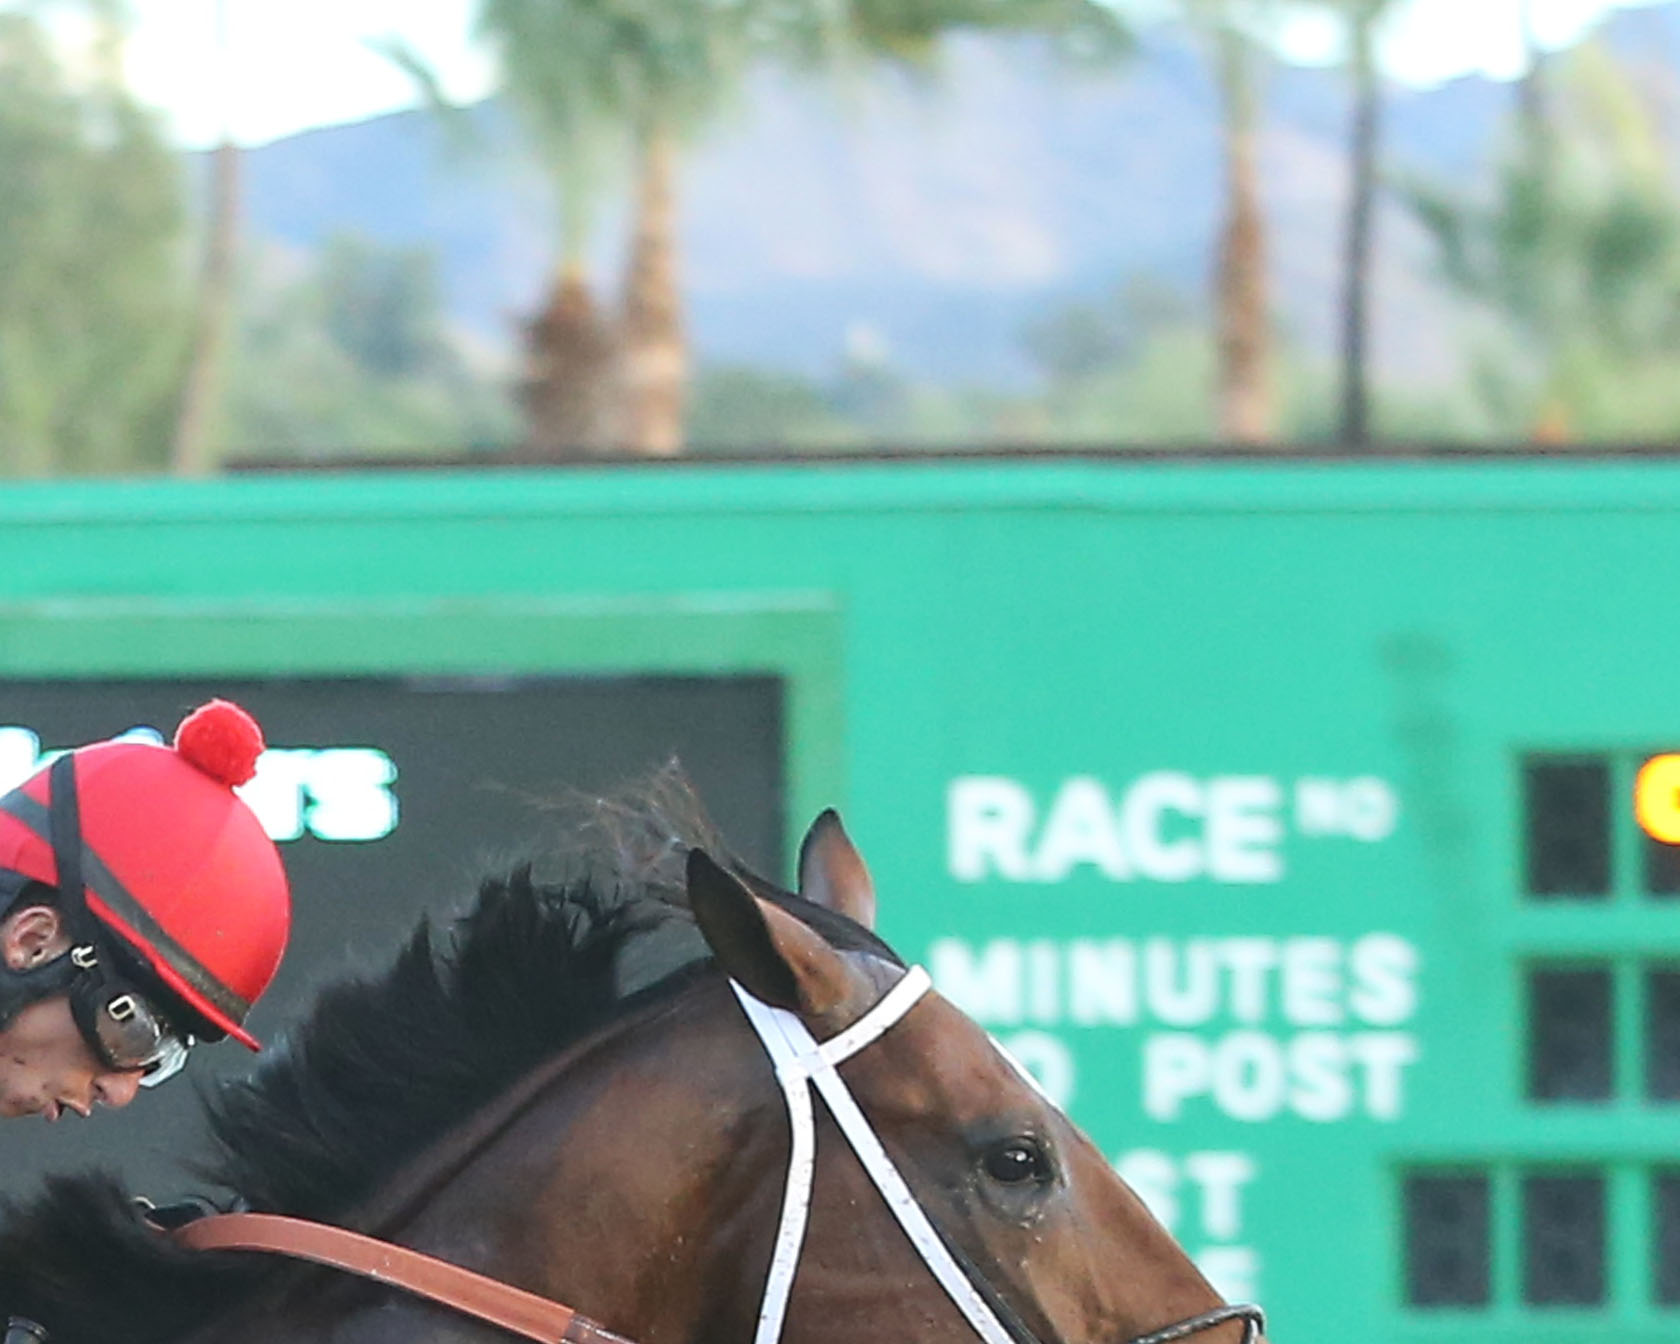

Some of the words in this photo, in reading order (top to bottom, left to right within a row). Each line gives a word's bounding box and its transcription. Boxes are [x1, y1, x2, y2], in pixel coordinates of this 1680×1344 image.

[947, 770, 1286, 884] RACE
[930, 931, 1420, 1028] MINUTES
[1140, 1030, 1418, 1124] POST
